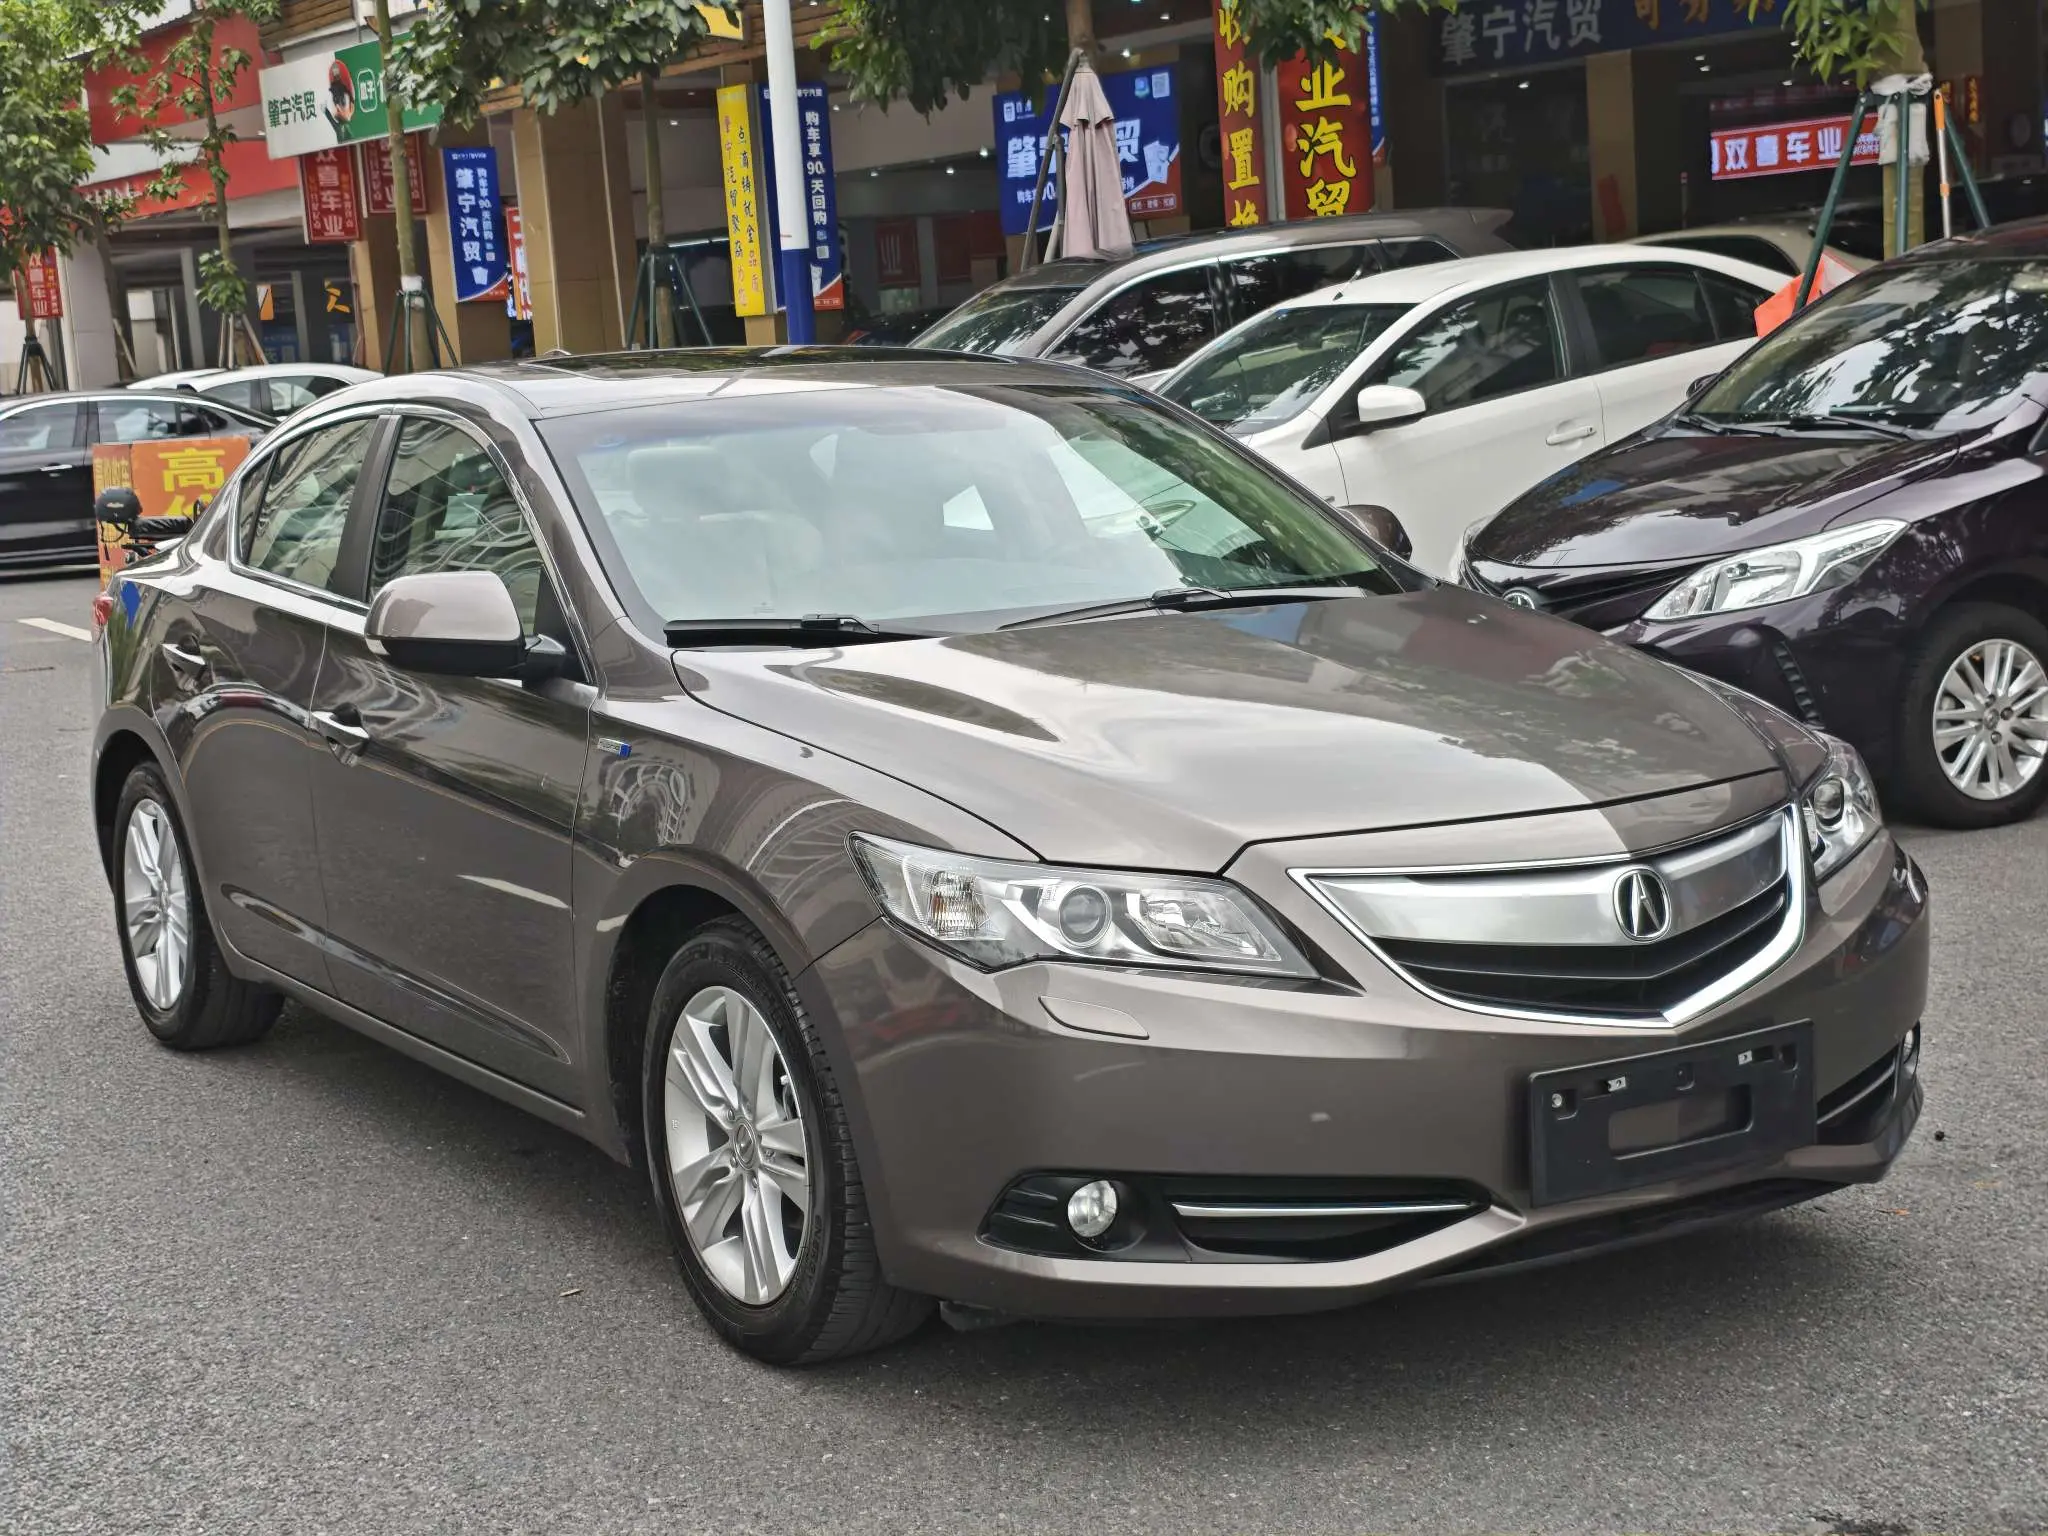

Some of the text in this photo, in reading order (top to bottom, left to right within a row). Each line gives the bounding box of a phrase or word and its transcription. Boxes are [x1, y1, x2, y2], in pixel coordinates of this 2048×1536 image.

[1441, 0, 1602, 65] 肇宁汽贸
[1295, 28, 1357, 217] 业汽贸
